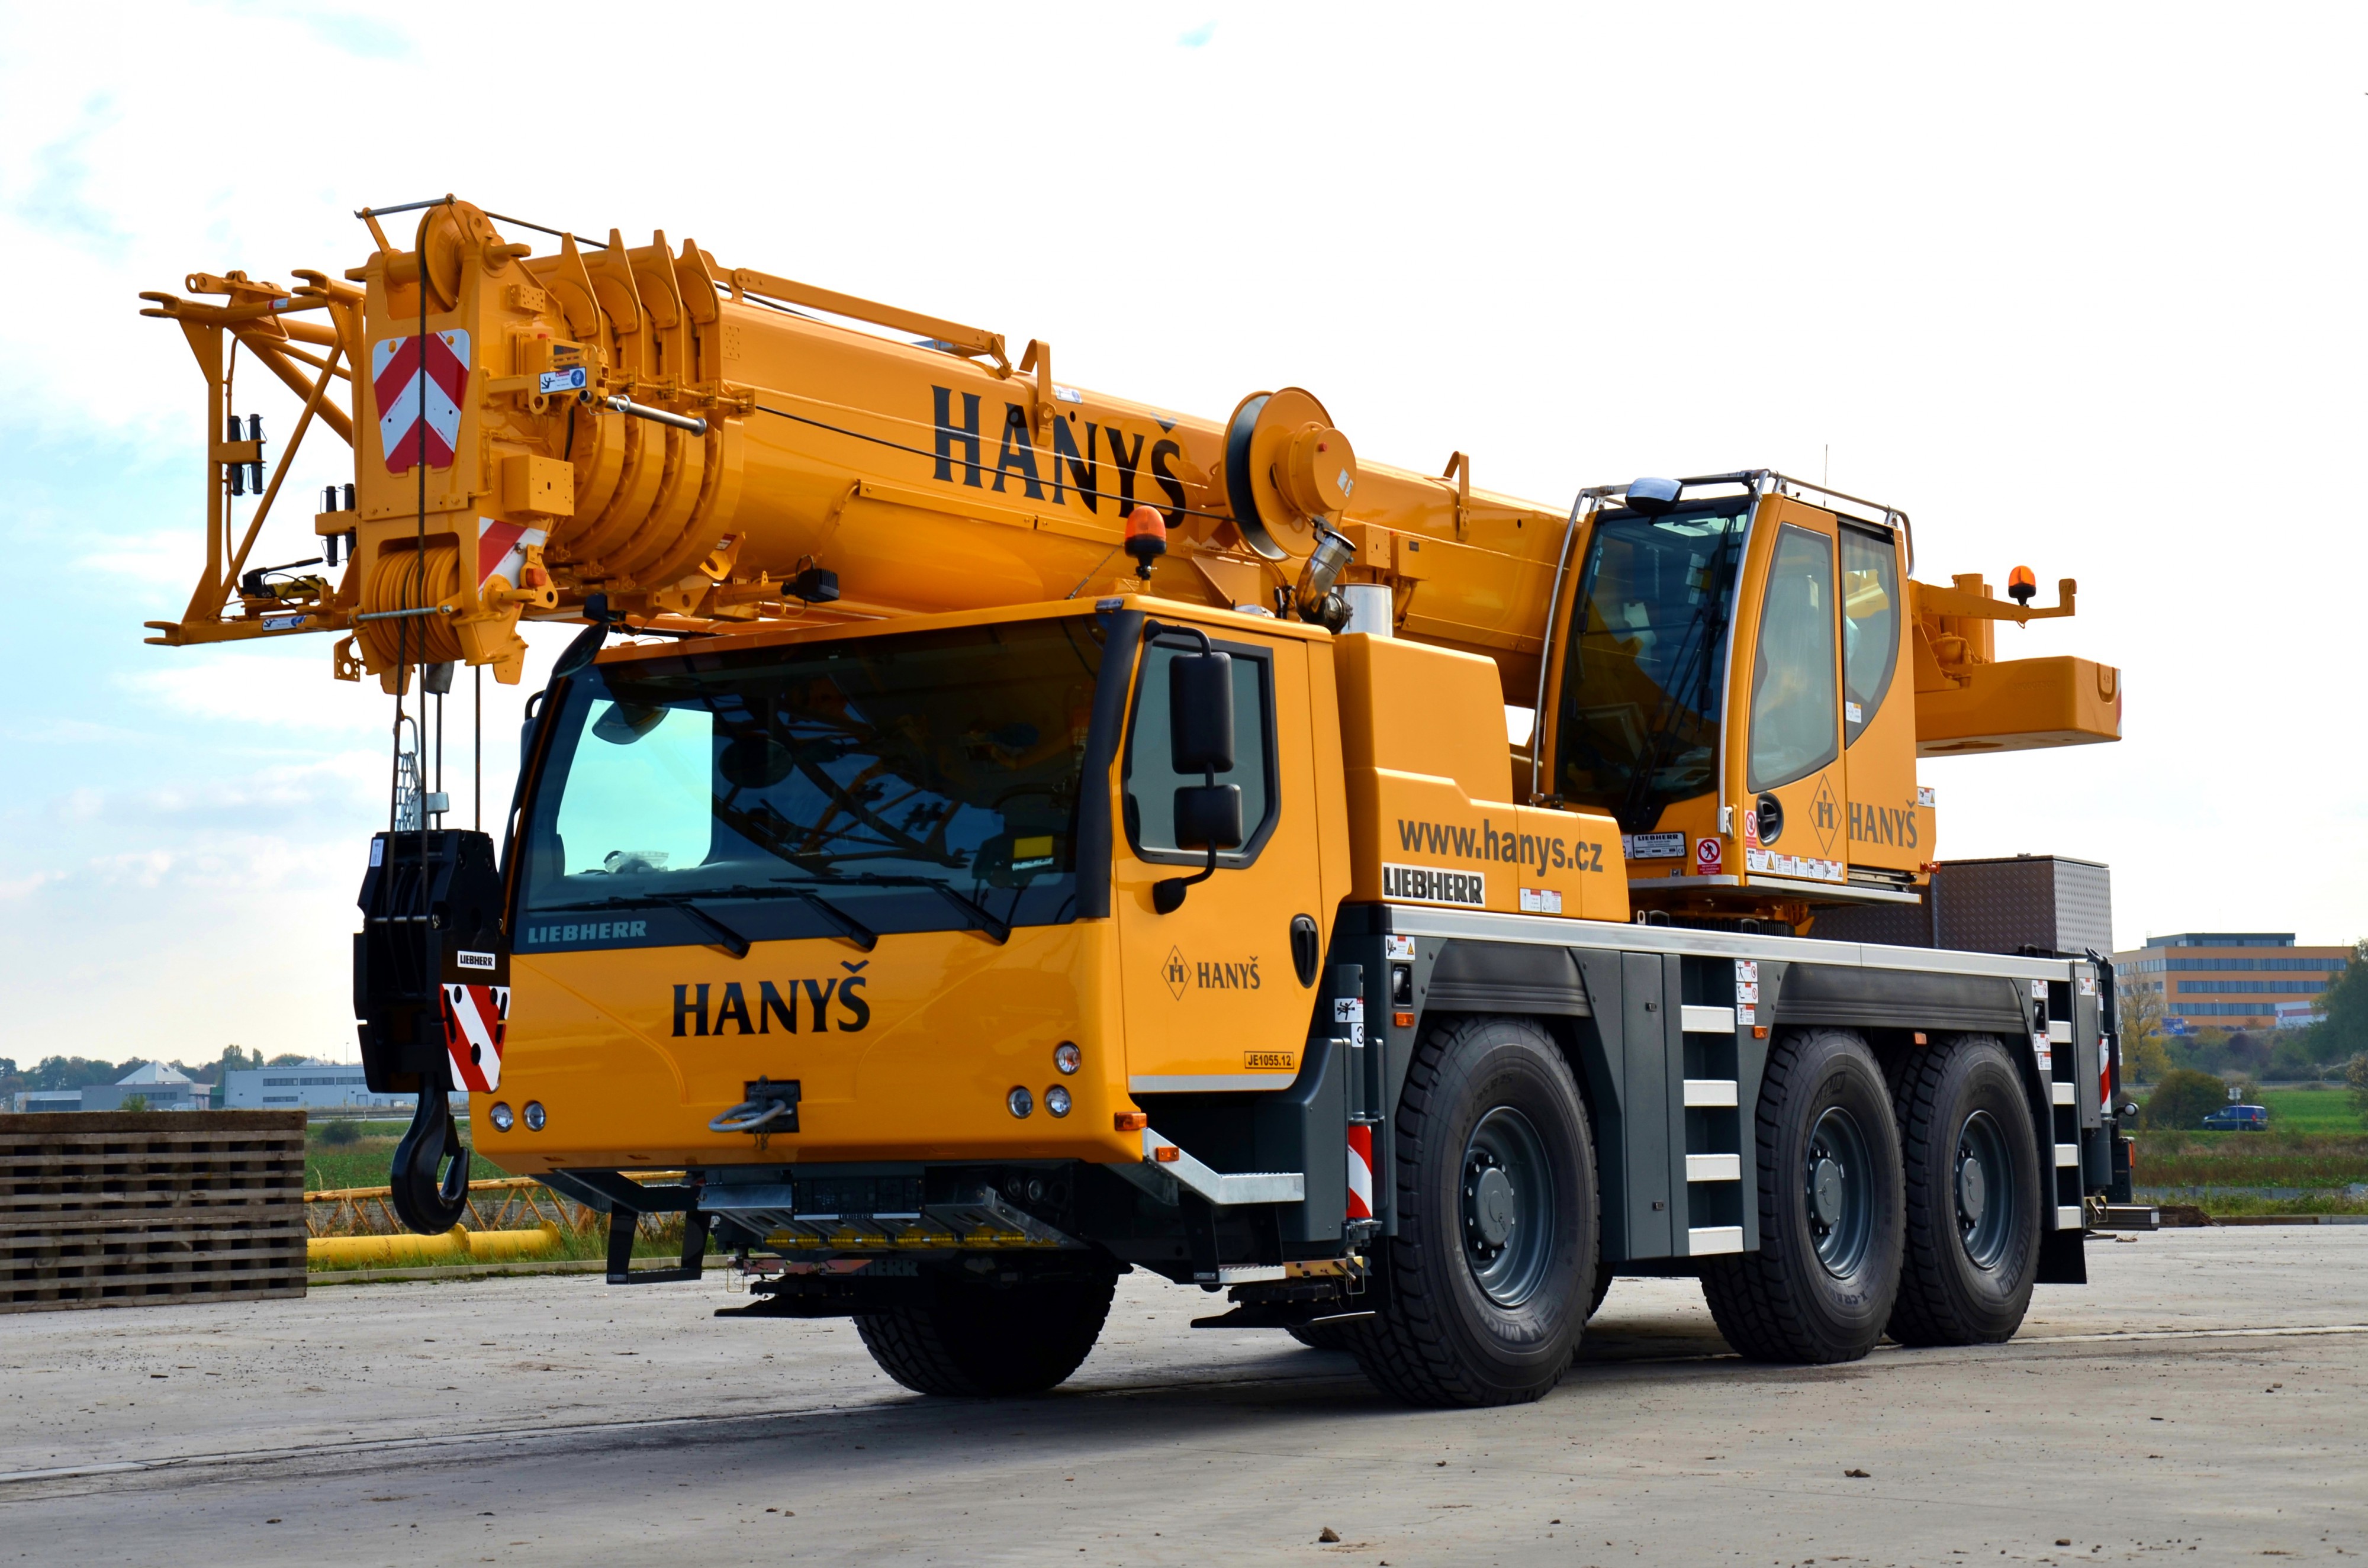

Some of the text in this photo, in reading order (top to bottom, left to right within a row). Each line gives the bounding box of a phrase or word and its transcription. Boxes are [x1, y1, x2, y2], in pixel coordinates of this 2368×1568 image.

[931, 385, 1186, 529] HANYŠ
[1848, 799, 1917, 848] HANYŠ
[1397, 819, 1603, 877] www.hanys.cz
[1384, 867, 1483, 903] LIEBHERR
[528, 920, 646, 944] LIEBHERR
[459, 954, 493, 967] LIEBHERR
[1198, 956, 1260, 989] HANYŠ
[671, 960, 870, 1037] HANYŠ
[1357, 1026, 1363, 1044] 3
[1248, 1055, 1292, 1067] JE1055.12
